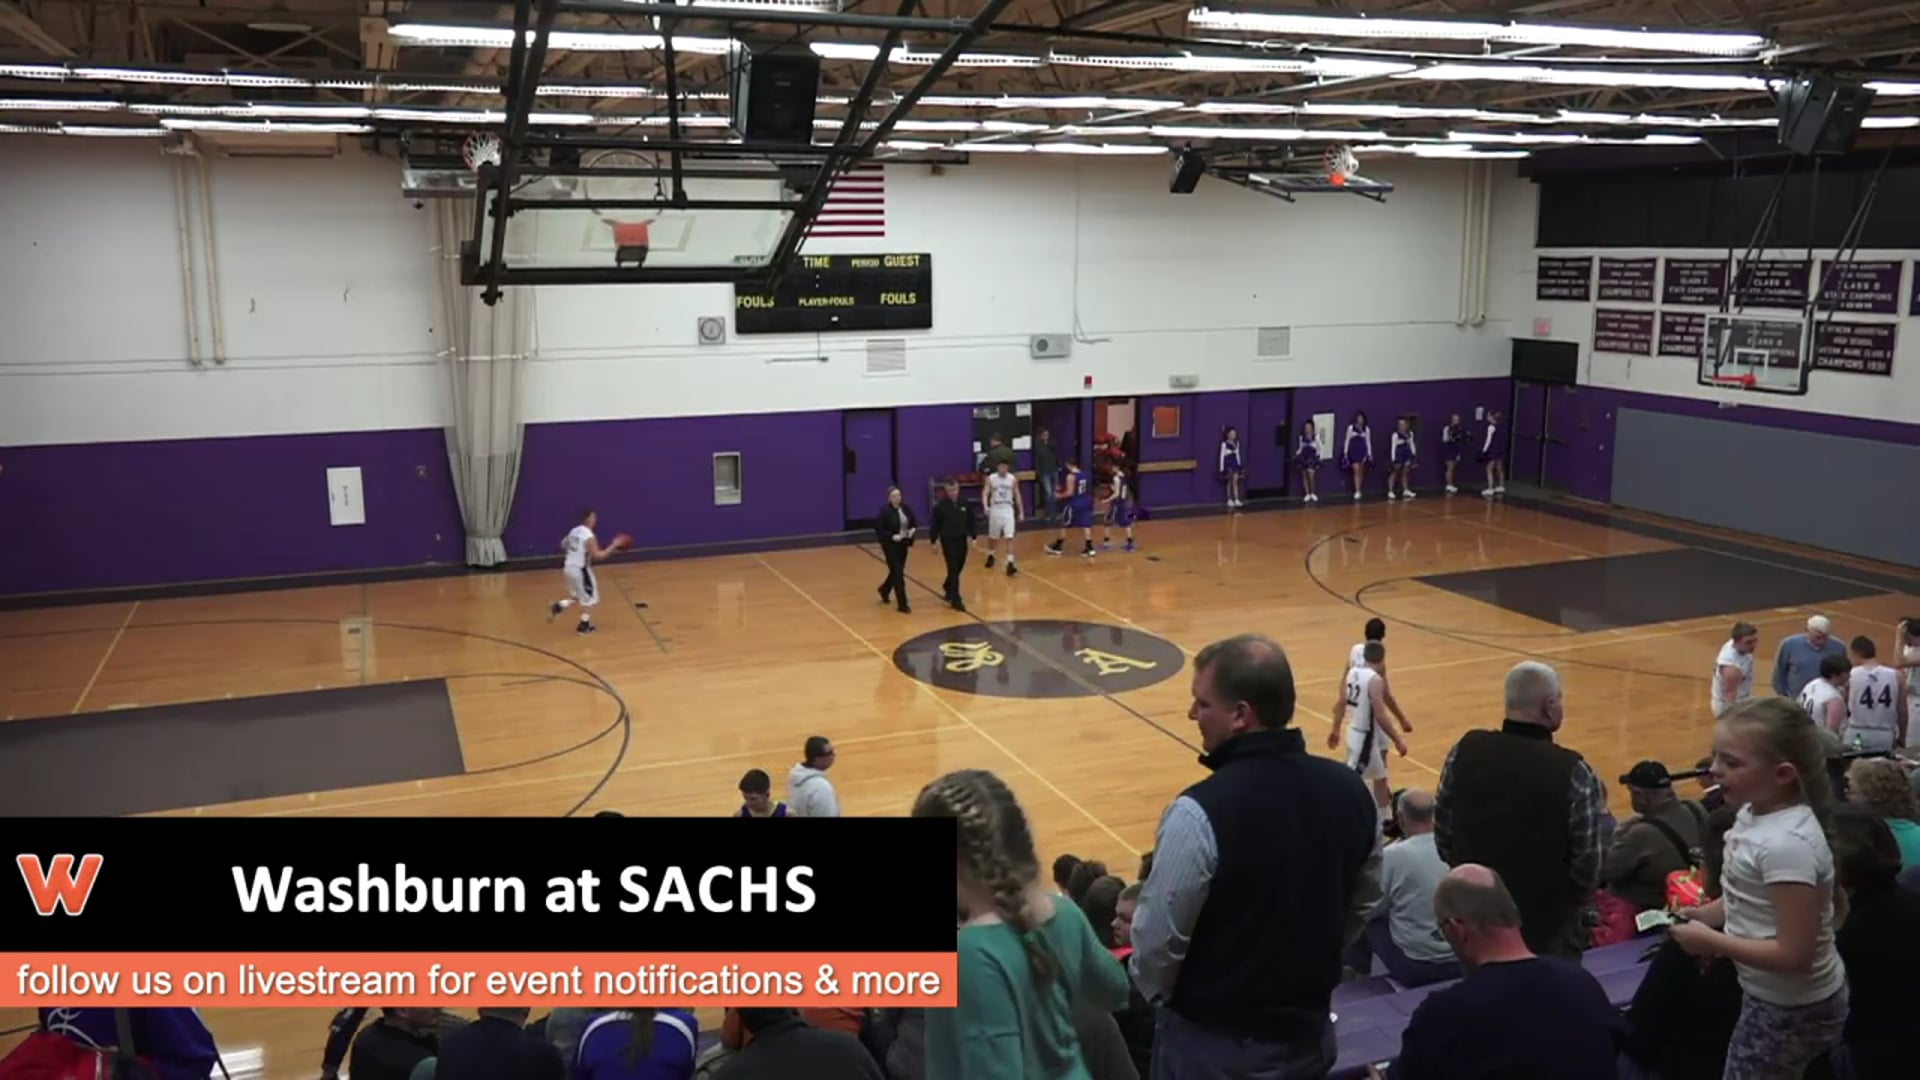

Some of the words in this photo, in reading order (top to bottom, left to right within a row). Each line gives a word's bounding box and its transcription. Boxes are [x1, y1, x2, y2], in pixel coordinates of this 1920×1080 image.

[803, 257, 830, 269] TIME
[851, 259, 879, 268] PERIOD
[884, 255, 920, 267] GUEST
[737, 296, 775, 308] FOULS
[880, 293, 916, 305] FOULS
[1817, 356, 1864, 370] CHAMPIONS
[1859, 683, 1893, 709] 44
